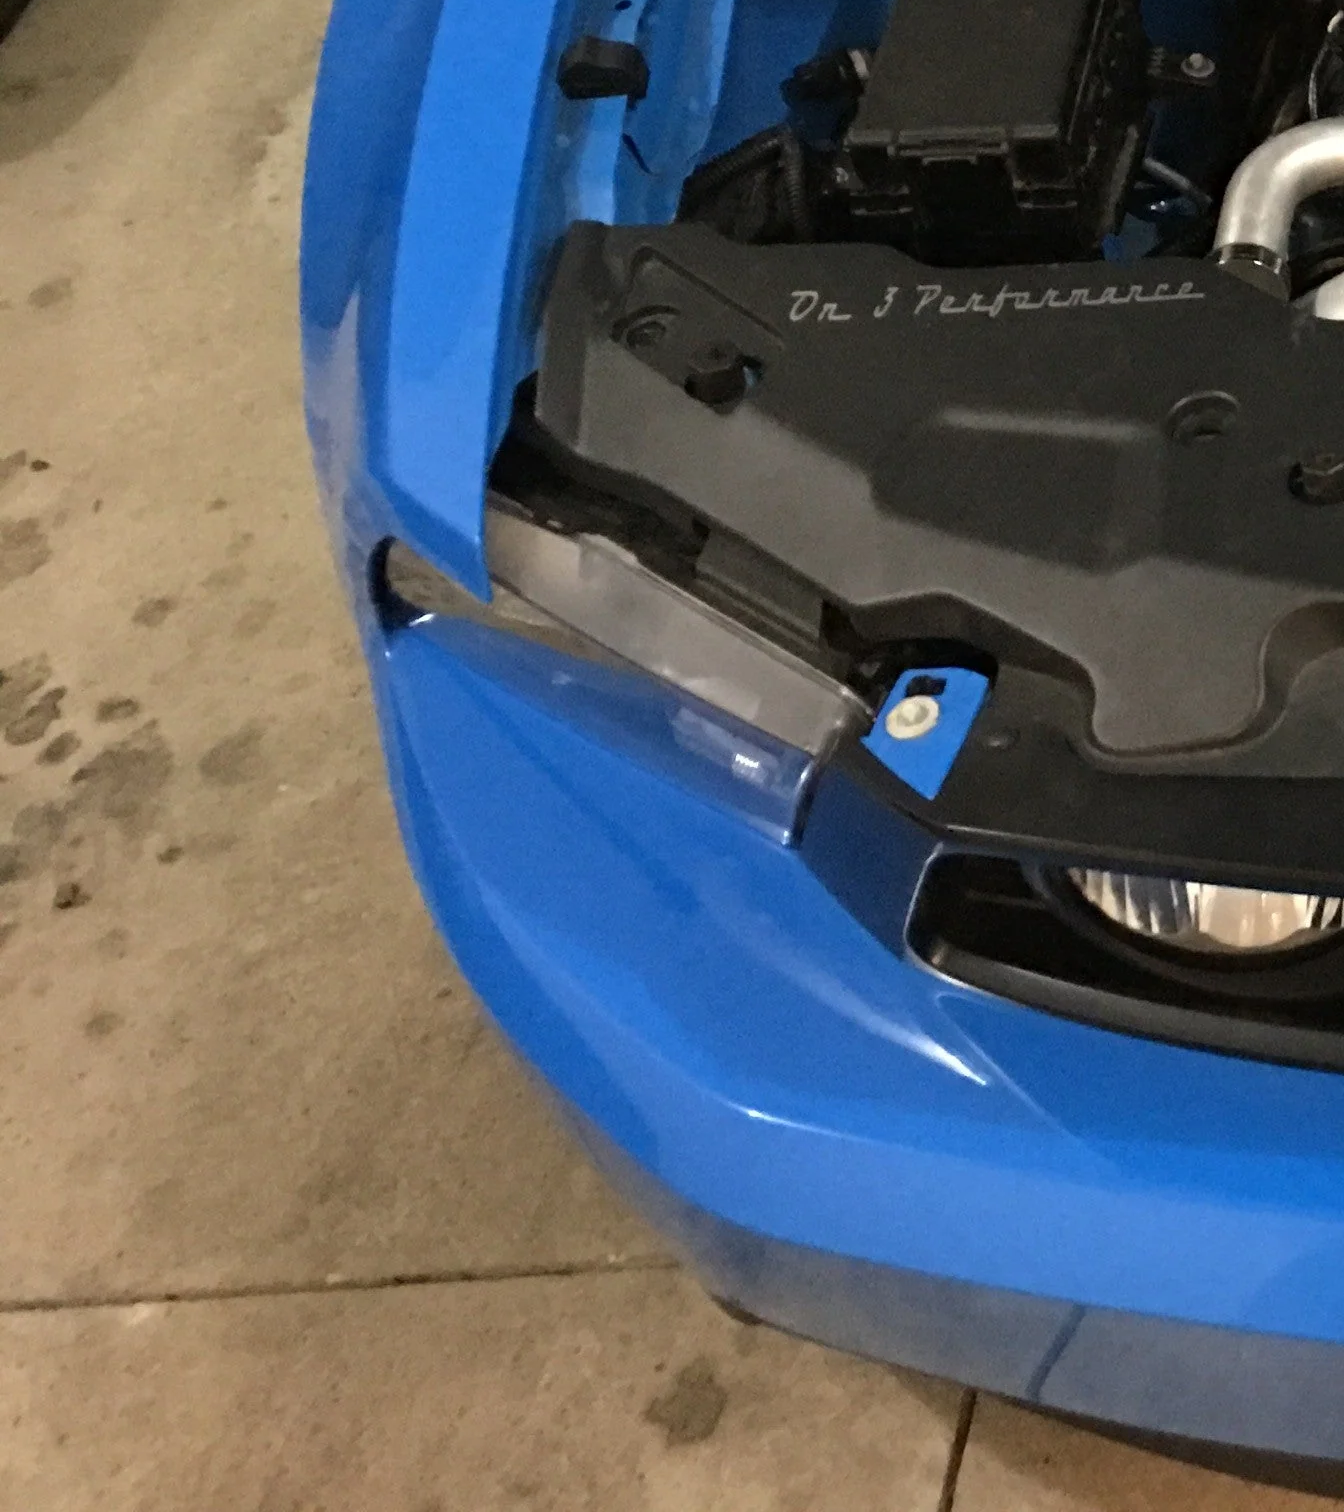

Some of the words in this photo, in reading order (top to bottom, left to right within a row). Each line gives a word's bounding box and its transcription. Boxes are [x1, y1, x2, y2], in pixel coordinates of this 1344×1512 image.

[787, 290, 851, 322] On
[873, 286, 900, 318] 3
[914, 281, 1205, 319] Performance
